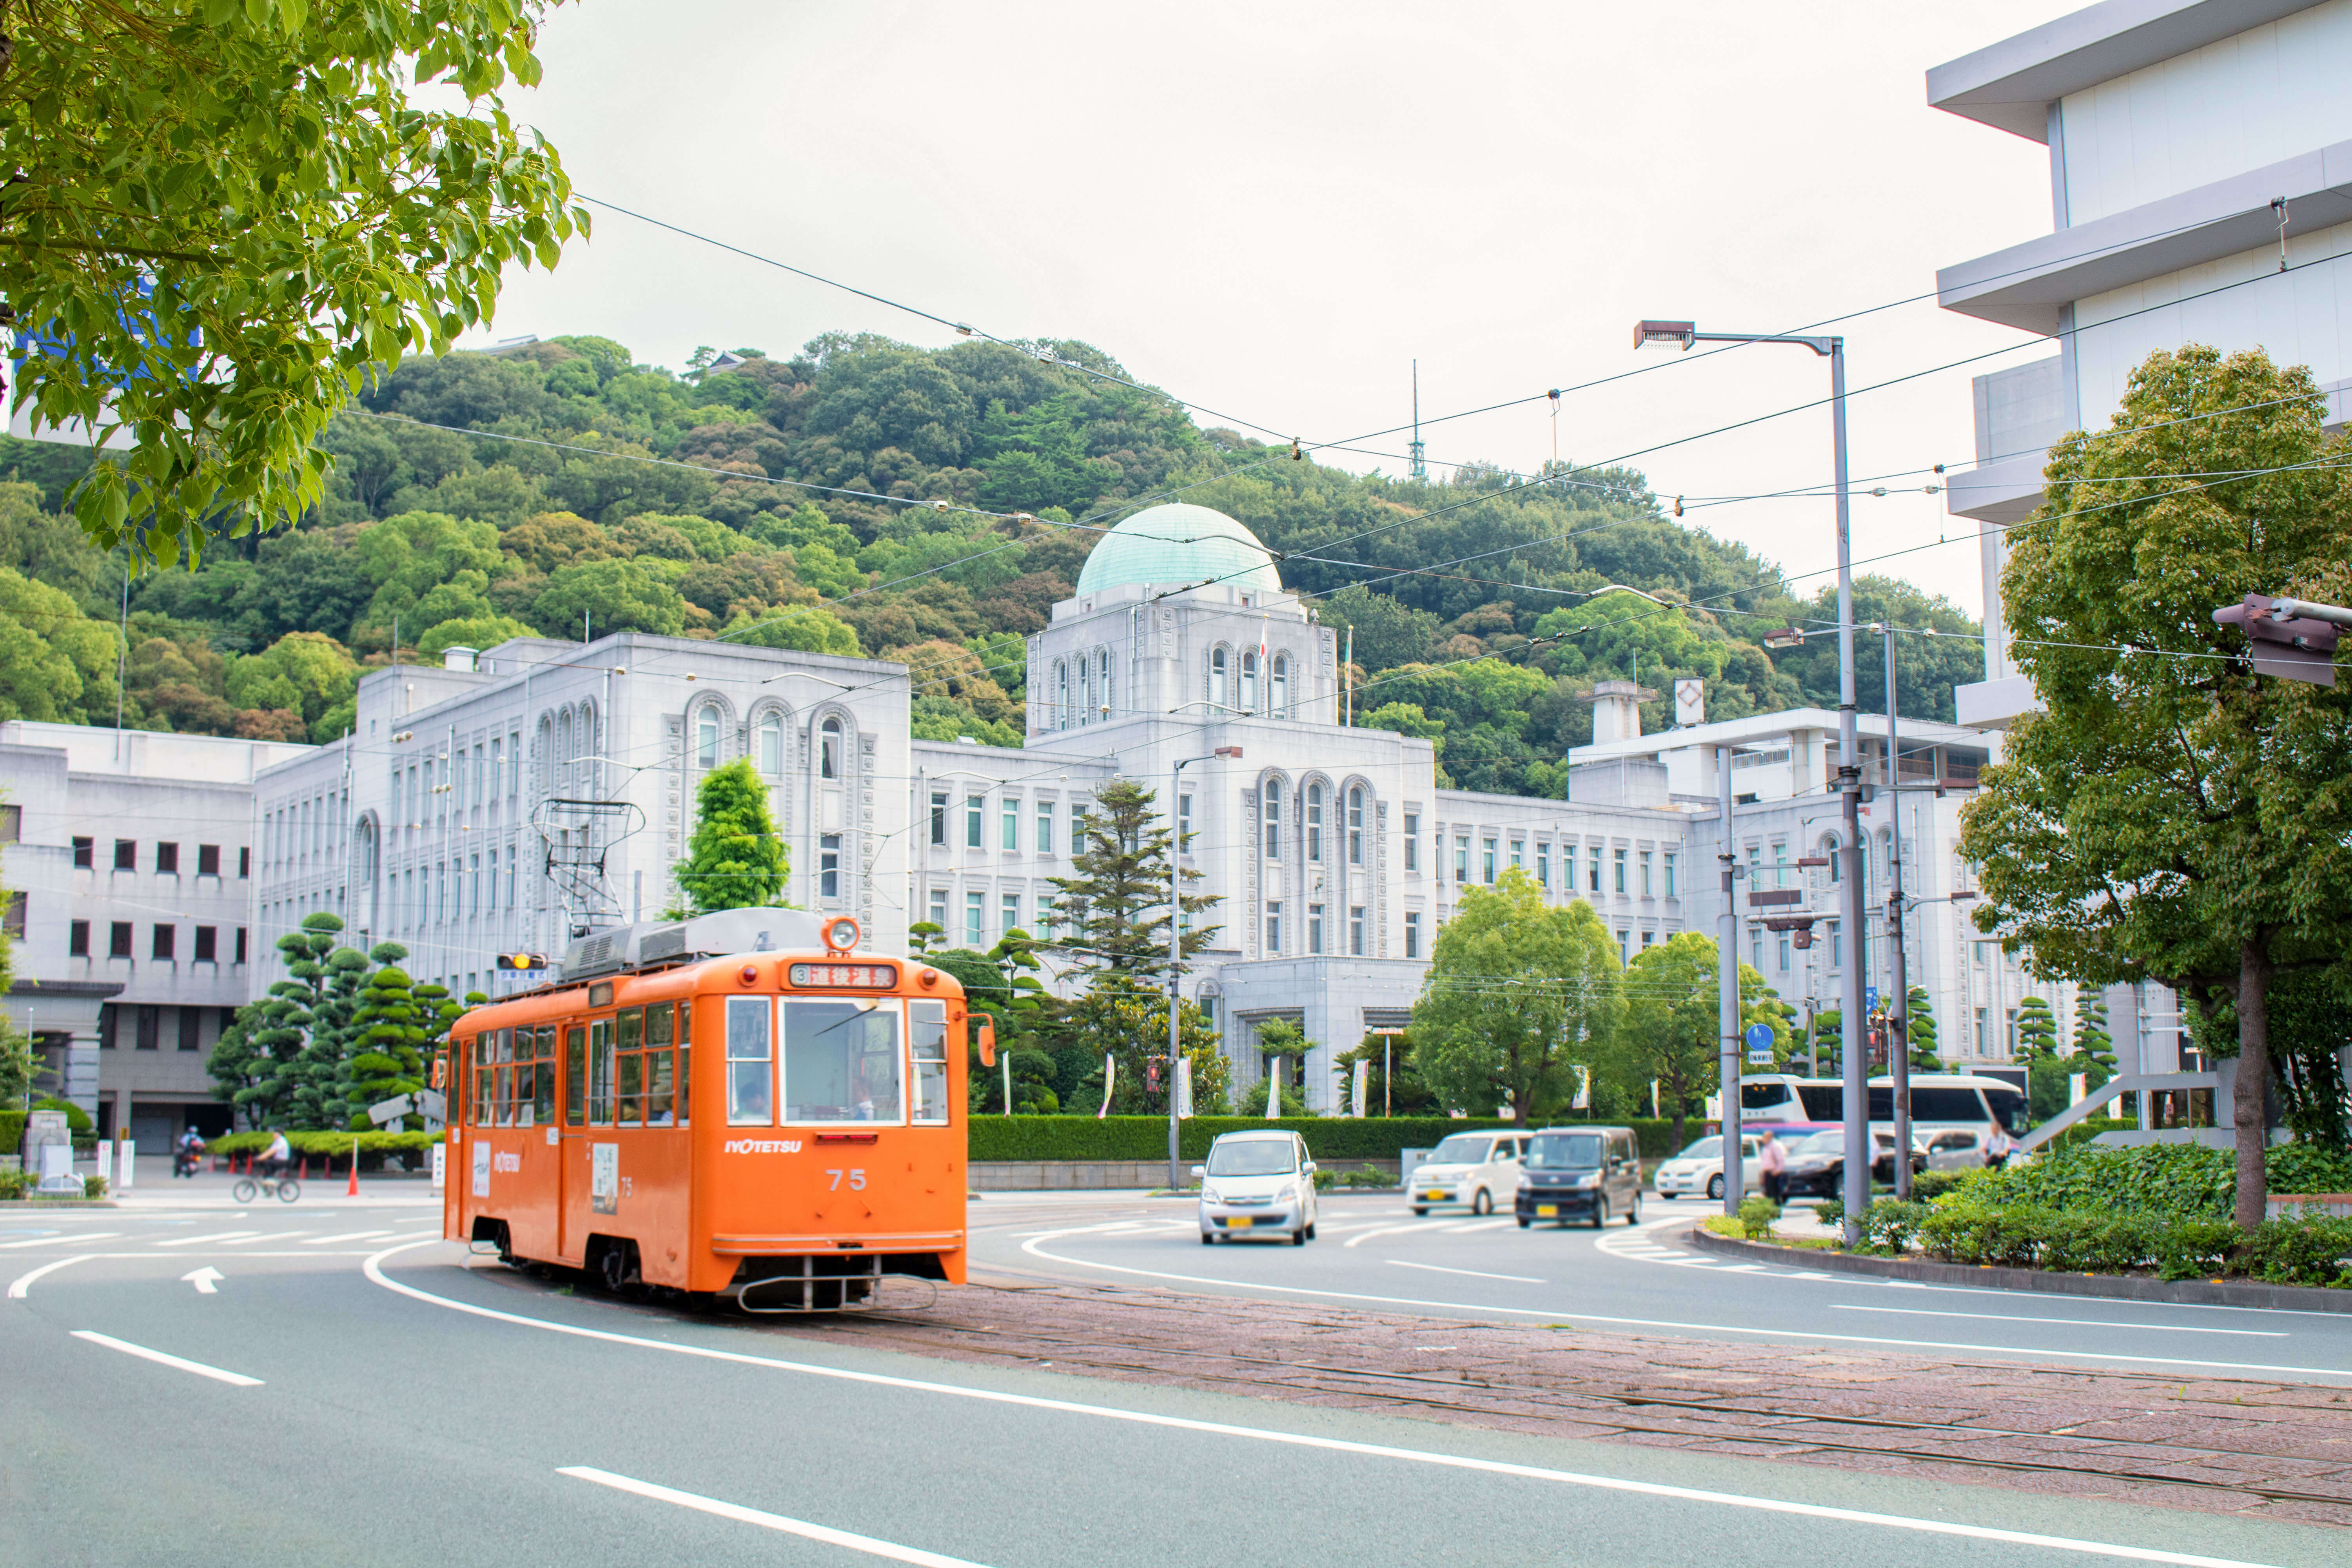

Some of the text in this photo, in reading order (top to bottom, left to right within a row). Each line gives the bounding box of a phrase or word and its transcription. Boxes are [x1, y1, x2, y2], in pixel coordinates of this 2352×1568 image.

[812, 966, 891, 986] 道後温泉
[724, 1139, 802, 1154] IYOTETSU
[621, 1177, 632, 1197] 75
[826, 1169, 867, 1191] 75
